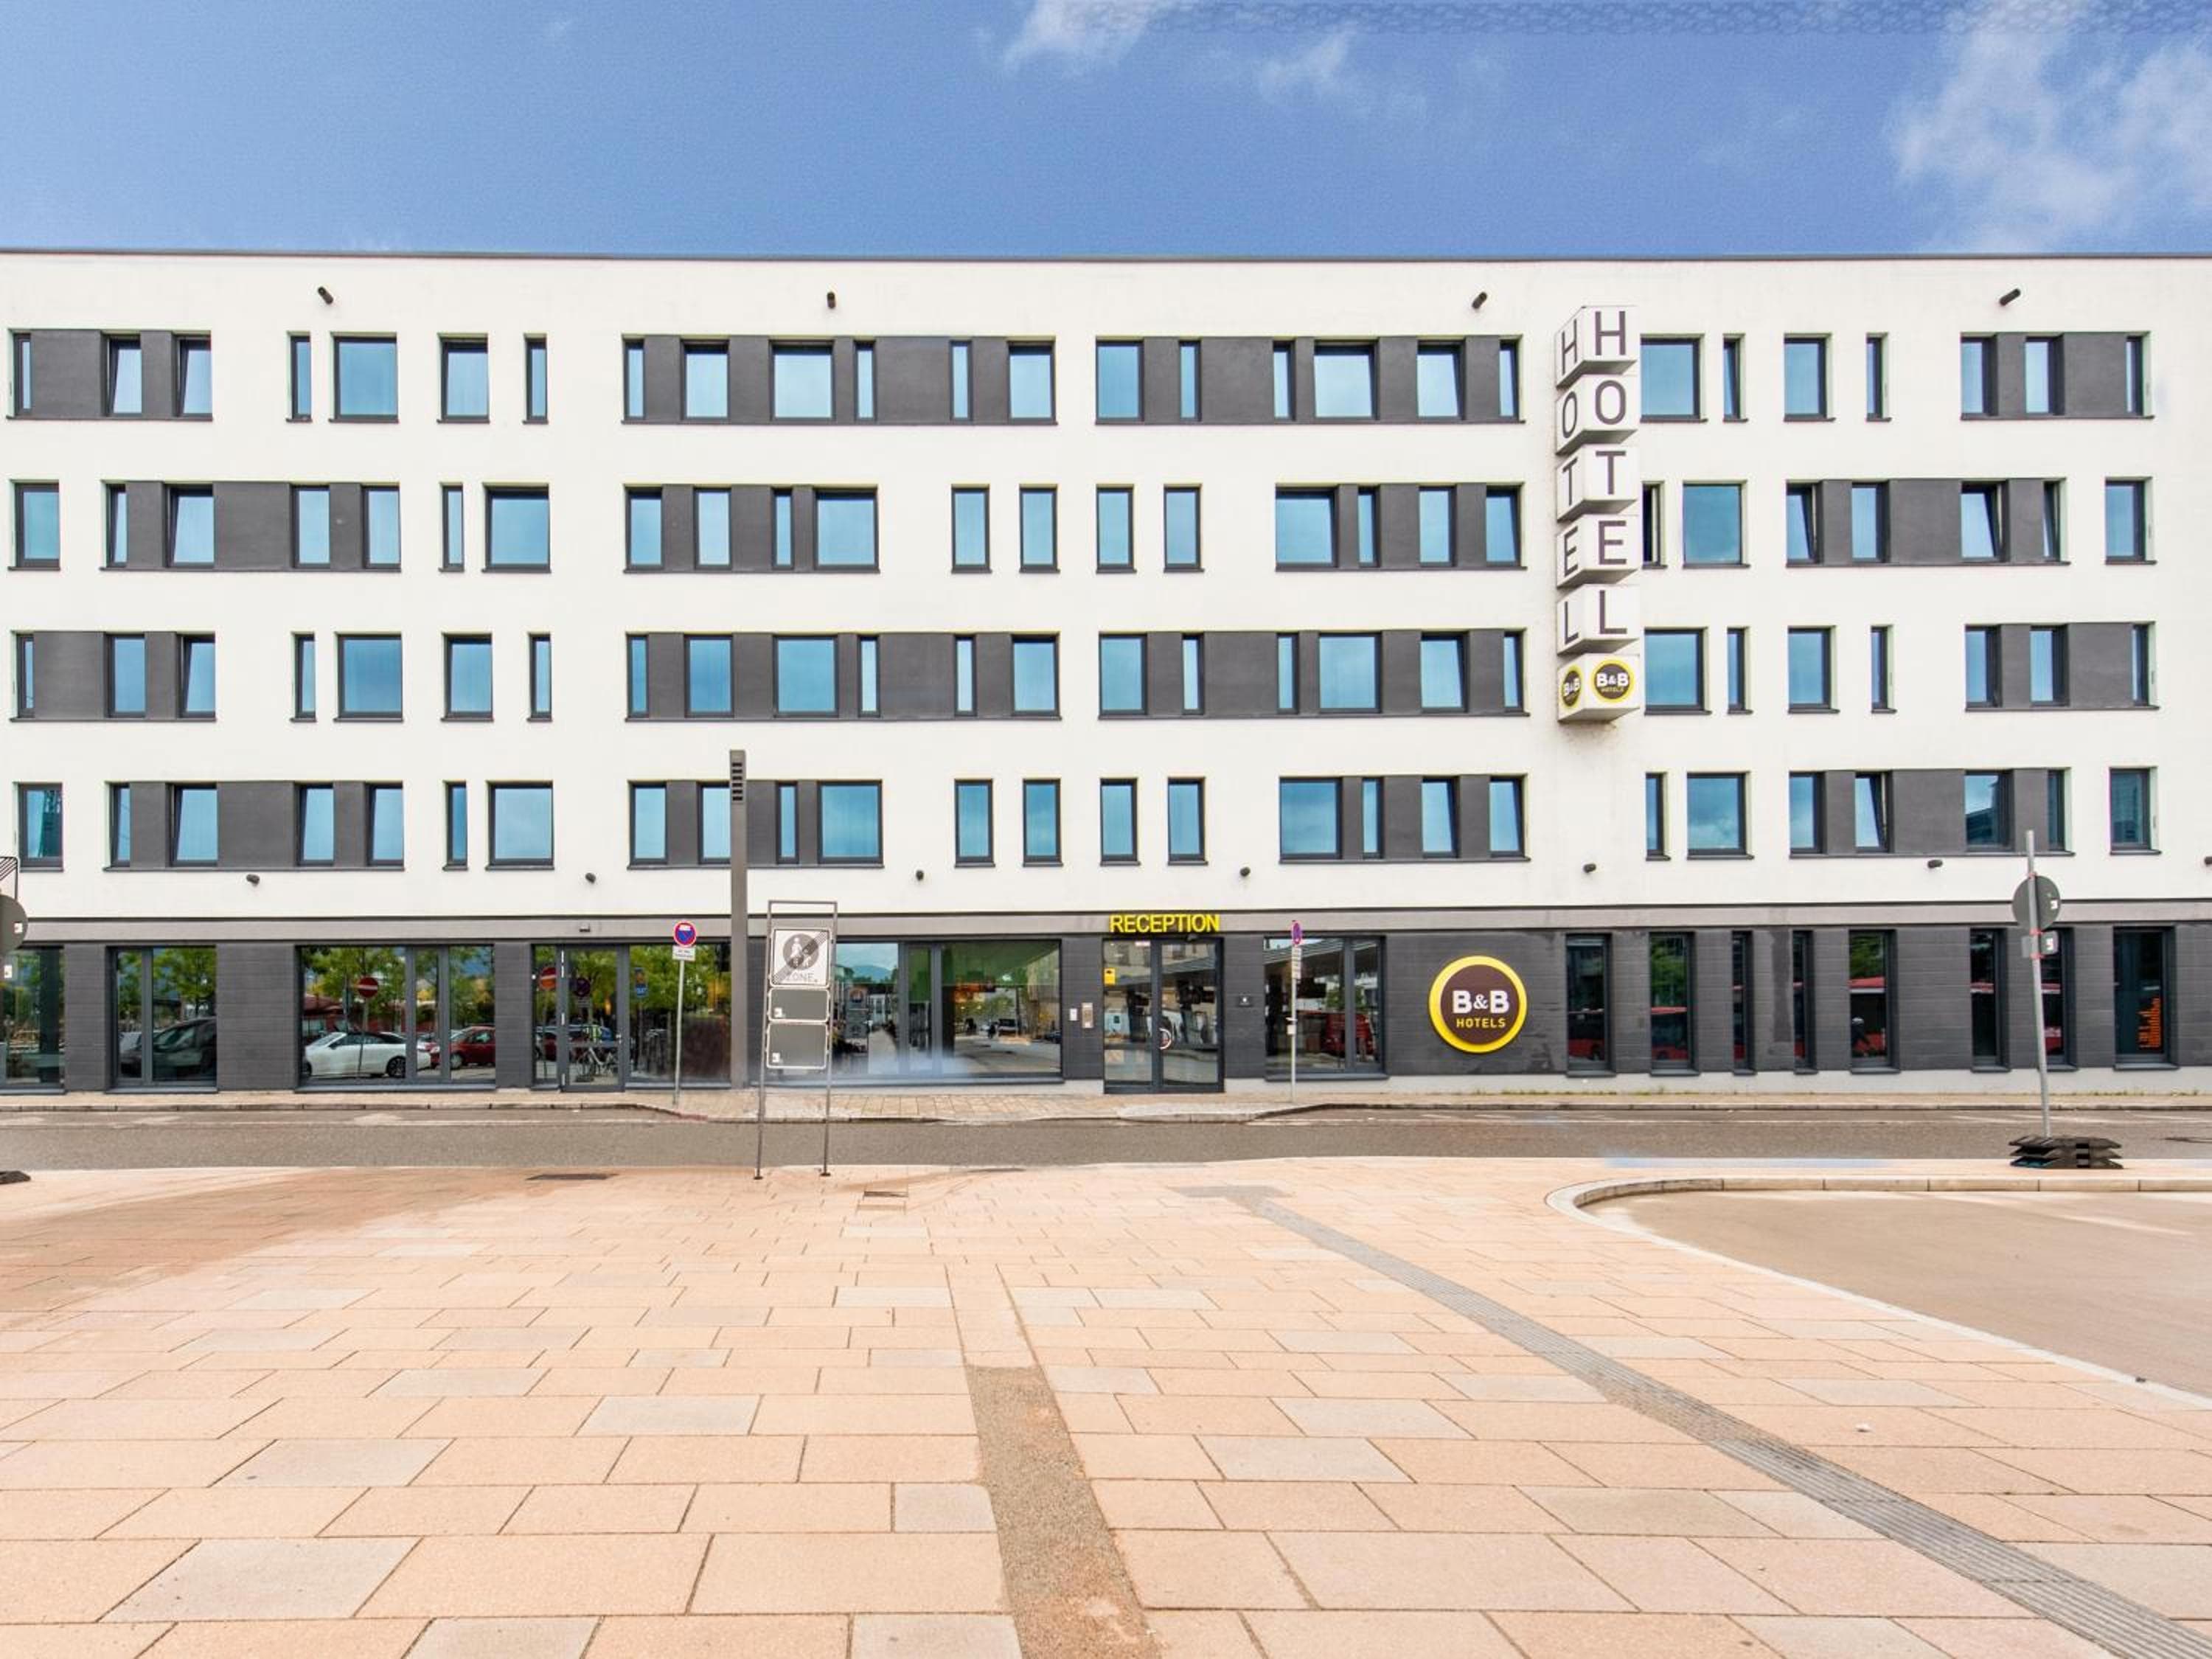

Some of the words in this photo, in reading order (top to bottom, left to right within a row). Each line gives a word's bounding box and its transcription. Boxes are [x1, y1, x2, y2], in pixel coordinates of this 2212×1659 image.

[1561, 319, 1579, 645] HOTEL
[1595, 310, 1627, 634] HOTEL
[1596, 672, 1628, 687] B&B
[1110, 914, 1221, 933] RECEPTION
[1453, 990, 1509, 1013] B&B
[1456, 1018, 1506, 1029] HOTELS
